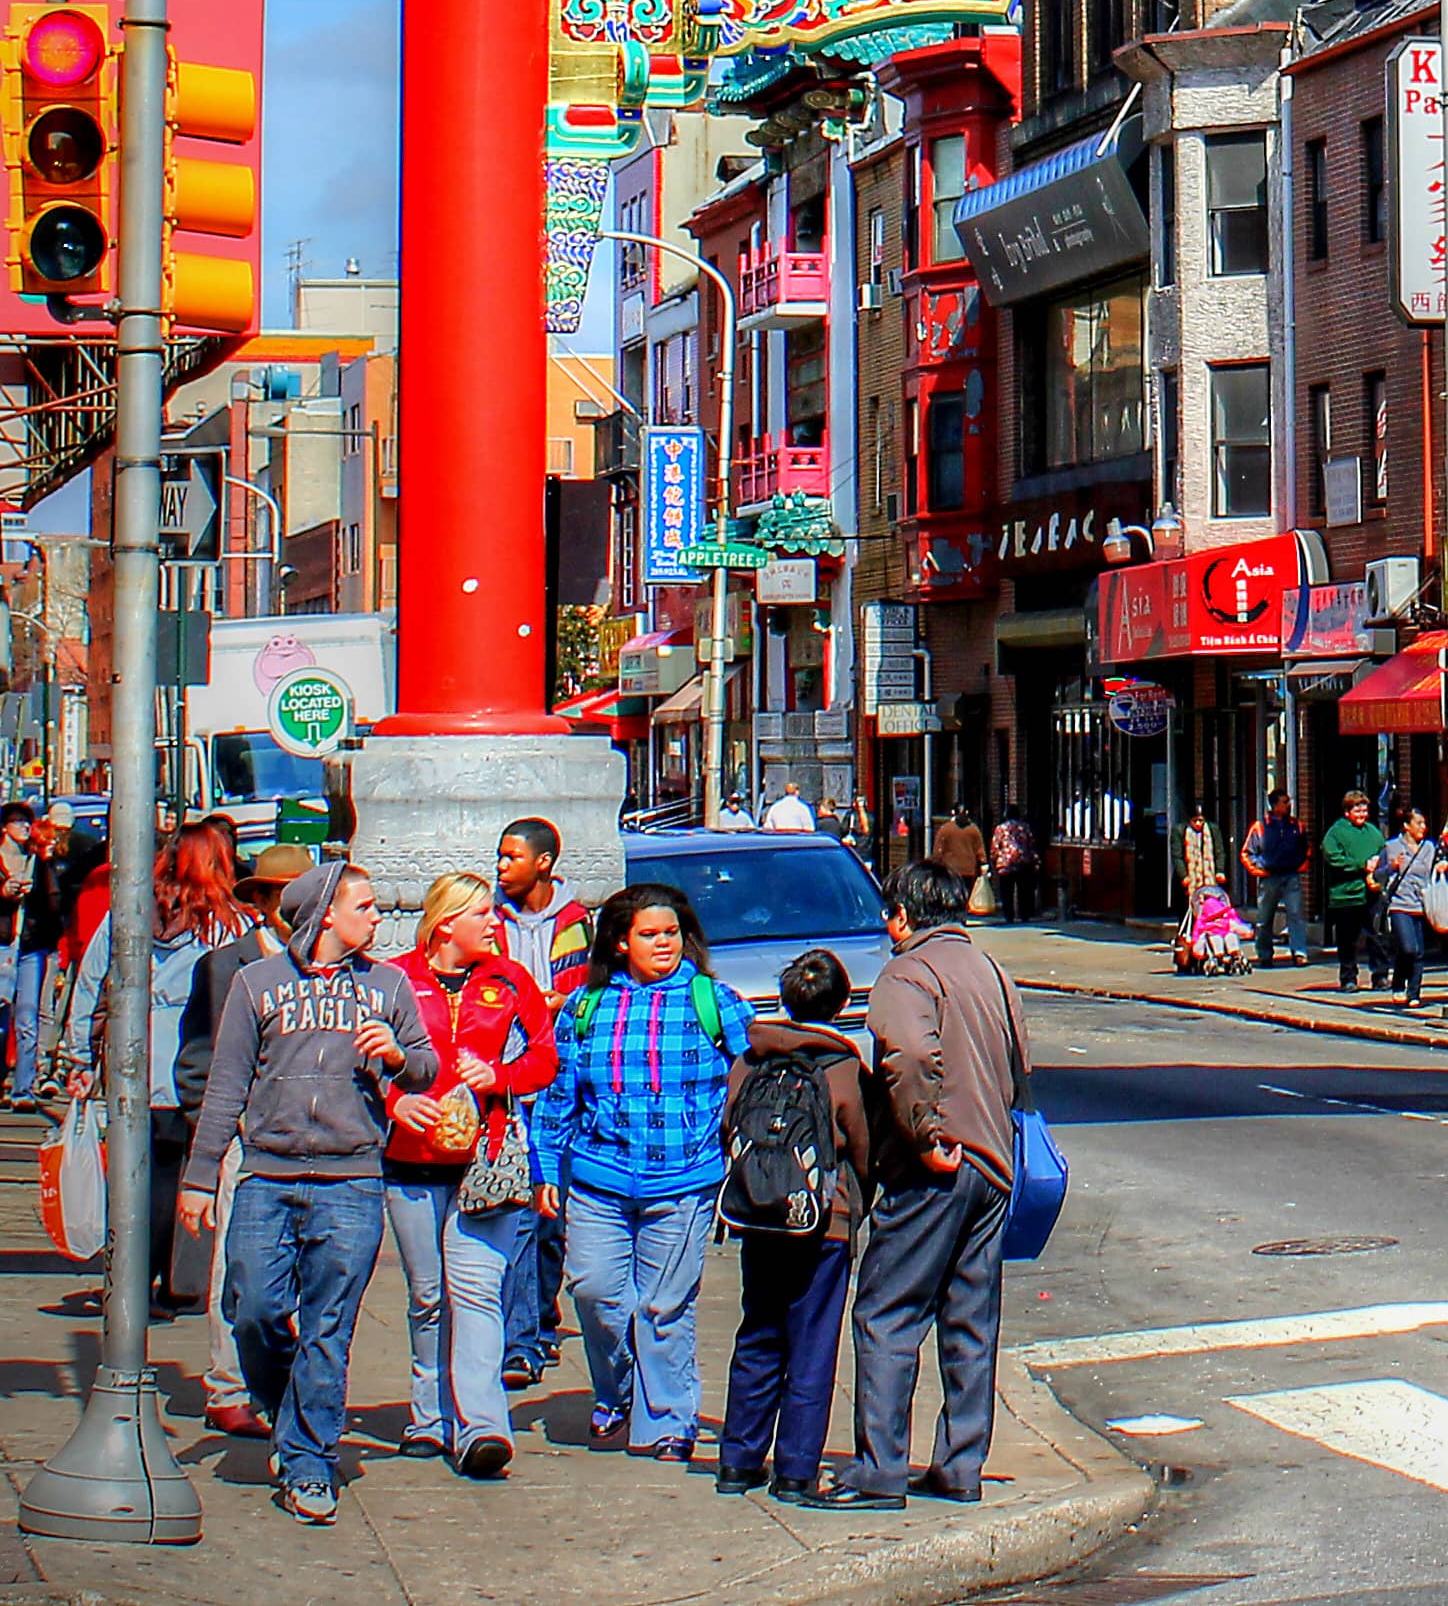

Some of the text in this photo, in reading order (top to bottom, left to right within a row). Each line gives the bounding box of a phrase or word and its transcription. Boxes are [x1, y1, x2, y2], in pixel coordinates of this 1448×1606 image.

[678, 551, 753, 567] APPLETREE
[755, 557, 766, 566] ST
[1230, 557, 1275, 578] Asia
[1117, 576, 1151, 654] Asia
[289, 683, 331, 696] KIOSK
[281, 696, 342, 711] LOCATED
[293, 709, 330, 723] HERE
[260, 977, 385, 1016] AMERICAN
